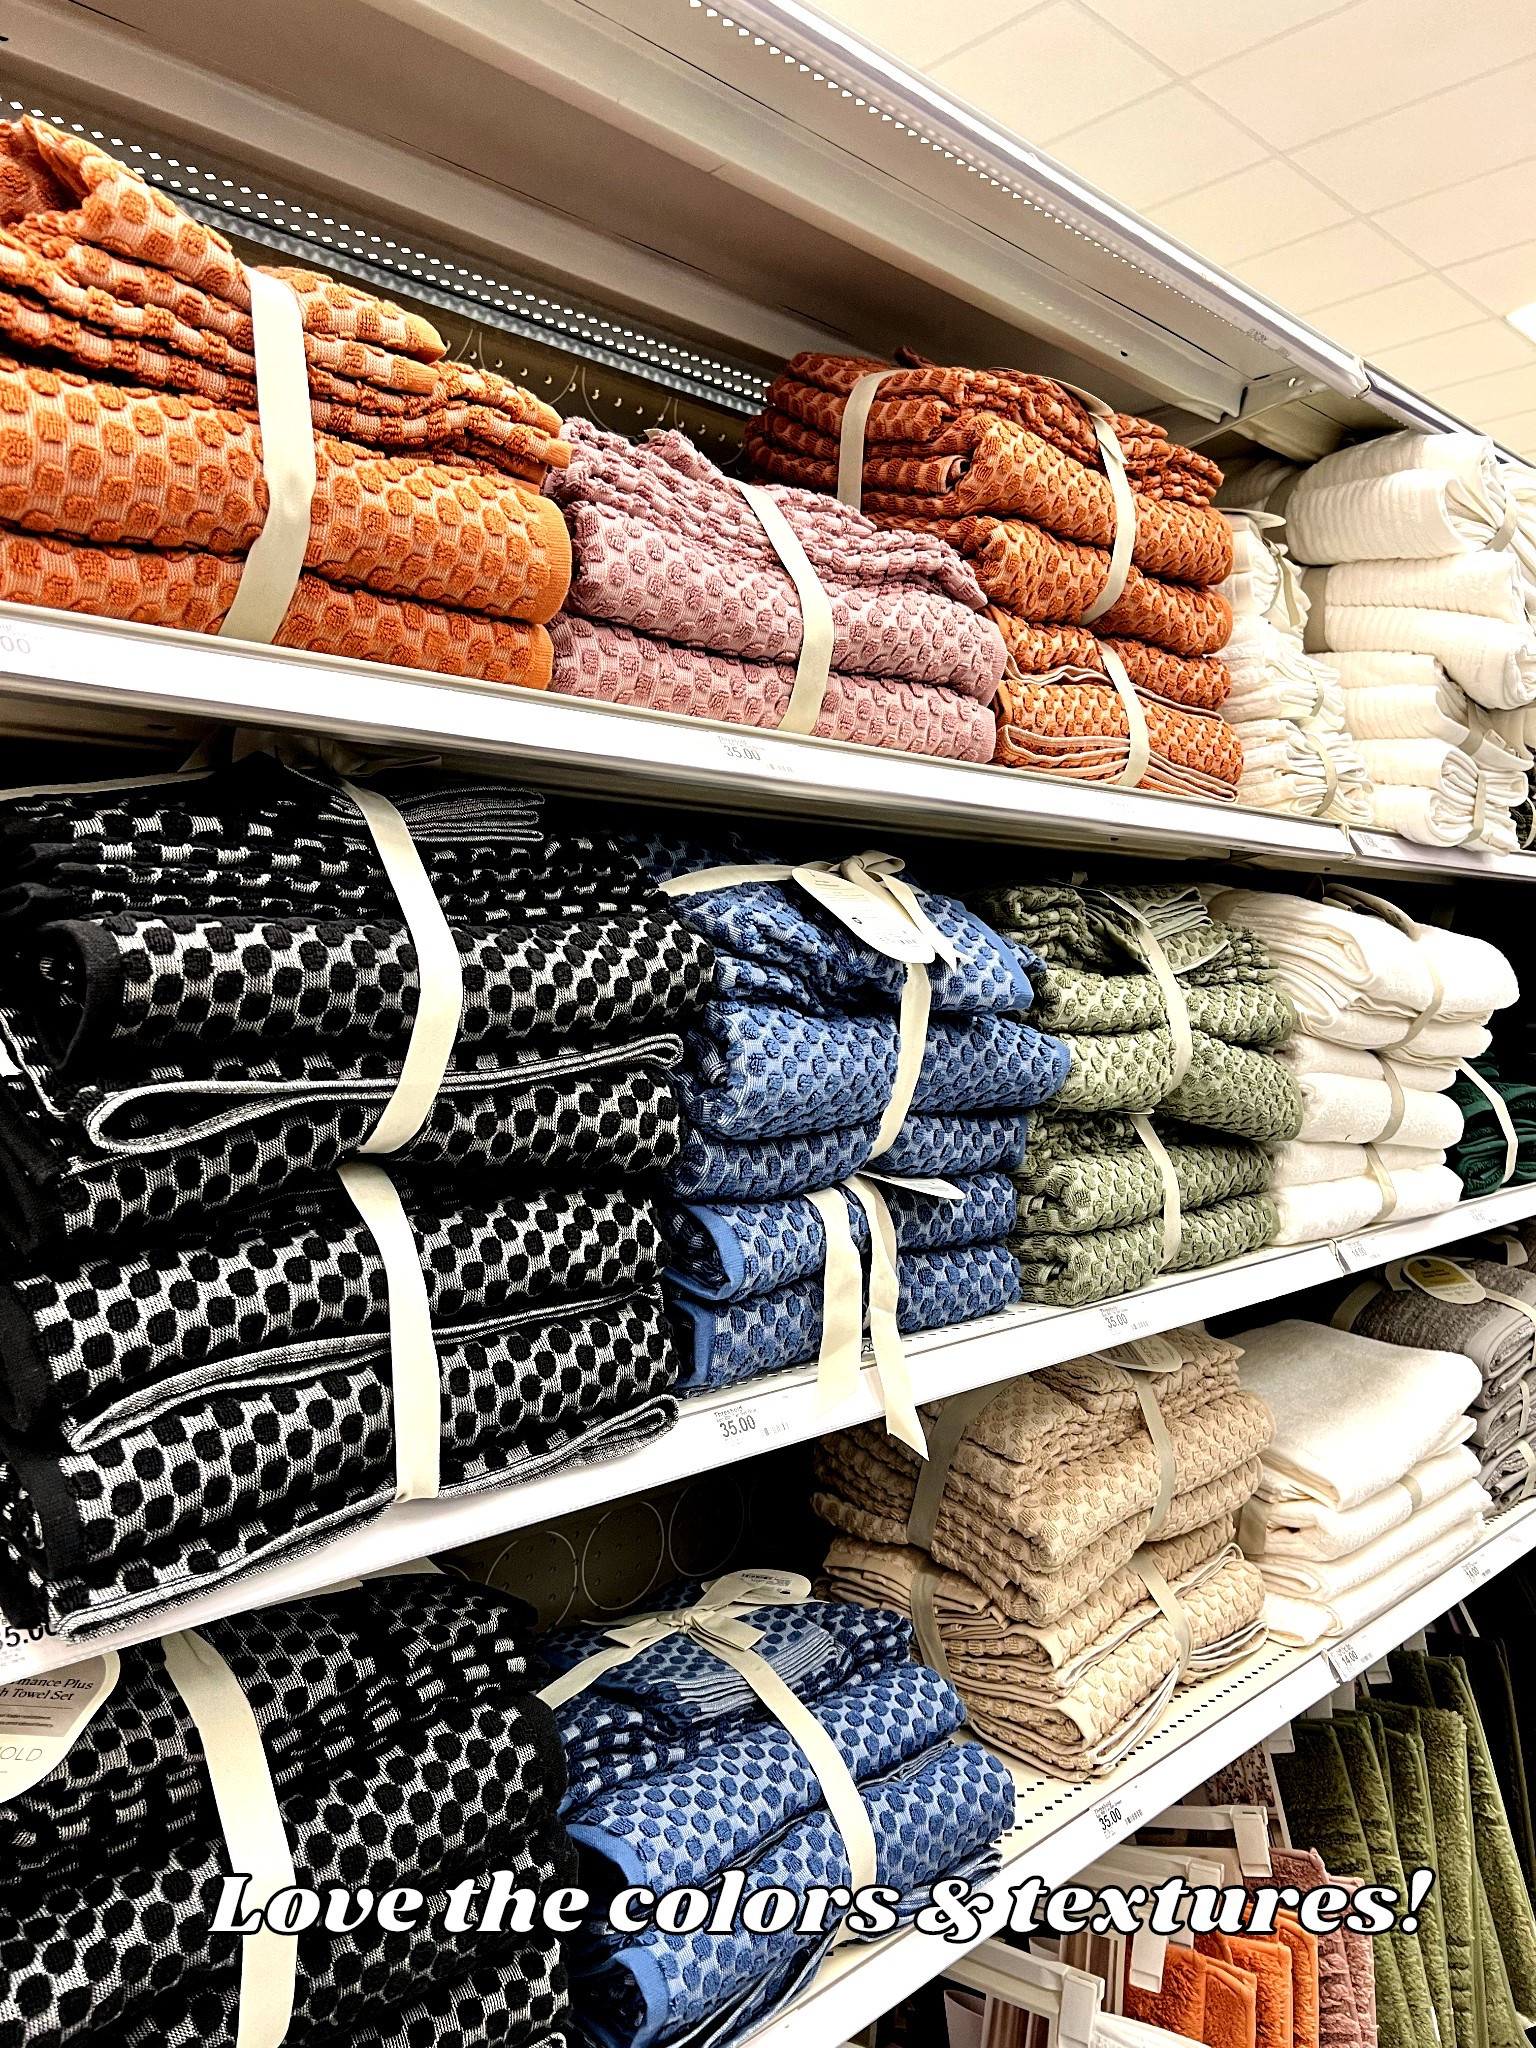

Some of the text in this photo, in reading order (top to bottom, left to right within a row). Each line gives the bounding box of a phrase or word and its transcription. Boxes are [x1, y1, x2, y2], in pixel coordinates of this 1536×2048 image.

[723, 744, 761, 761] 35.00
[1104, 1312, 1128, 1329] 35.00
[719, 1415, 756, 1438] 35.00
[63, 1678, 94, 1690] Plus
[12, 1688, 51, 1700] Towel
[50, 1690, 75, 1701] Set
[1098, 1807, 1122, 1831] 35.00
